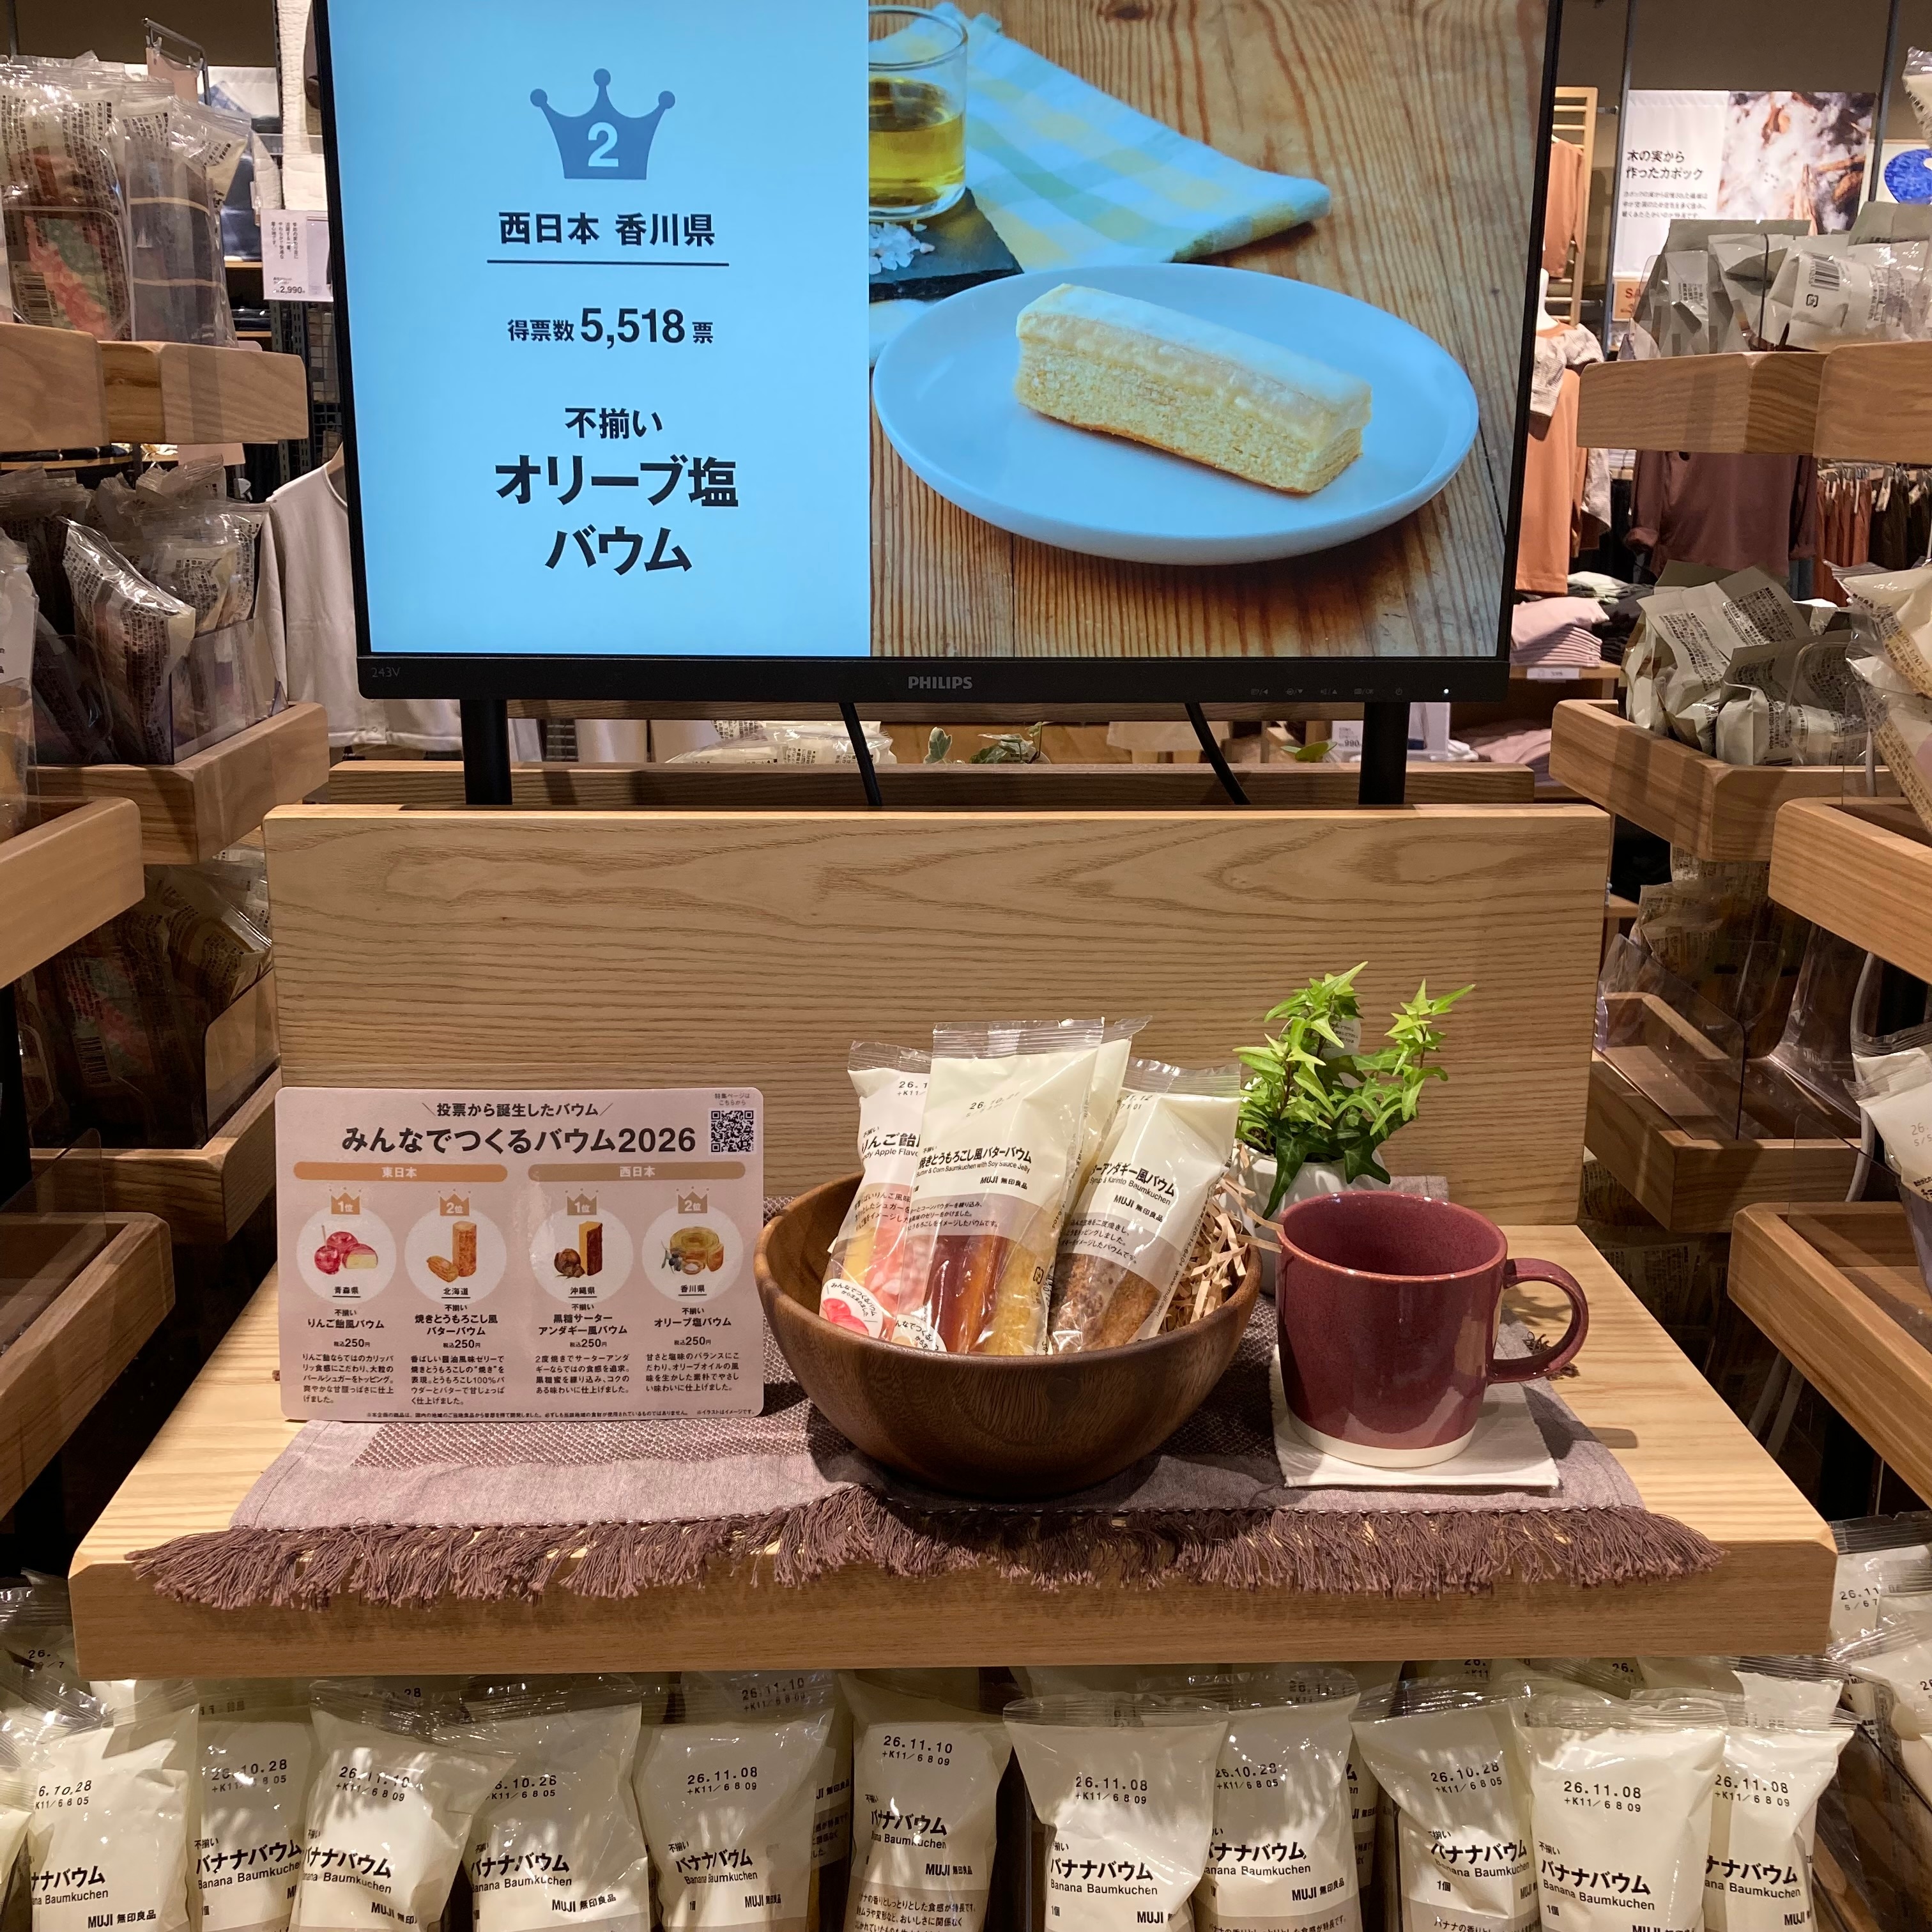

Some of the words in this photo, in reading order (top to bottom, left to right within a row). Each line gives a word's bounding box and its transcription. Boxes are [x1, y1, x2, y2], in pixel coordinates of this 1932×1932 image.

[588, 121, 620, 168] 2
[1627, 150, 1685, 163] 木の実から
[1626, 166, 1704, 181] 作ったカポック
[499, 211, 600, 247] 西日本
[615, 213, 716, 248] 香川県
[565, 407, 663, 440] 不揃い
[495, 454, 739, 507] オリーブ塩
[546, 524, 693, 576] バウム
[371, 666, 401, 678] 243V
[908, 676, 973, 689] PHILIPS
[342, 1127, 696, 1154] みんなでつくるバウム2026
[862, 1133, 921, 1154] りんご飴
[874, 1147, 896, 1157] Apple
[381, 1167, 417, 1179] 東日本
[619, 1166, 656, 1178] 西日本
[980, 1176, 999, 1184] MUJI
[1000, 1177, 1028, 1190] 無印良品
[1128, 1180, 1171, 1206] Baumkuchen
[337, 1200, 354, 1213] 1位
[446, 1202, 464, 1214] 2位
[574, 1201, 591, 1213] 1位
[684, 1200, 702, 1212] 2位
[1114, 1194, 1135, 1208] MUJI
[1136, 1204, 1164, 1222] 無印良品
[334, 1286, 359, 1294] 青森県
[443, 1287, 468, 1296] 北海道
[570, 1286, 595, 1295] 沖縄県
[680, 1285, 705, 1293] 香川県
[334, 1308, 357, 1317] 不揃い
[415, 1314, 498, 1324] 焼きとうもろこし風
[553, 1314, 613, 1324] 黒糖サーター
[307, 1318, 385, 1330] りんご飴風バウム
[654, 1317, 732, 1328] オリーブ塩バウム
[427, 1326, 486, 1336] バターバウム
[538, 1325, 627, 1336] アンダギー風バウム
[334, 1338, 371, 1348] 税込250円
[443, 1339, 481, 1349] 税込250円
[569, 1338, 607, 1348] 税込250円
[674, 1336, 711, 1346] 税込250円
[535, 1385, 629, 1394] ある味わいに仕上げました。
[646, 1383, 733, 1392] い味わいに仕上げました。
[303, 1395, 334, 1404] げました。
[411, 1397, 464, 1406] く仕上げました。
[883, 1735, 953, 1754] 26.11.10
[938, 1757, 950, 1766] 09
[687, 1767, 757, 1785] 26.11.08
[1215, 1763, 1277, 1778] 26.10.28
[1430, 1762, 1499, 1782] 26.10.28
[273, 1775, 286, 1784] 05
[745, 1782, 757, 1790] 09
[1076, 1776, 1147, 1791] 26.11.08
[1266, 1779, 1278, 1787] 05
[1491, 1777, 1502, 1786] 05
[1715, 1774, 1788, 1793] 26.11.08
[39, 1780, 92, 1797] 6.10.28
[543, 1789, 556, 1797] 05
[1564, 1781, 1641, 1798] 26.11.08
[77, 1797, 89, 1806] 05
[392, 1792, 405, 1802] 09
[1135, 1795, 1147, 1804] 09
[1777, 1797, 1790, 1807] 09
[1627, 1803, 1641, 1813] 09
[194, 1837, 218, 1850] 不揃い
[668, 1840, 689, 1853] 不揃い
[1538, 1841, 1560, 1855] 不揃い
[196, 1839, 302, 1874] バナナバウム
[1430, 1839, 1527, 1865] バナナバウム
[305, 1845, 392, 1878] バナナバウム
[471, 1852, 570, 1878] バナナバウム
[675, 1848, 753, 1873] バナナバウム
[926, 1863, 950, 1876] MUJI
[1050, 1857, 1154, 1882] バナナバウム
[1241, 1864, 1311, 1876] Baumkuchen
[1475, 1861, 1529, 1878] Baumkuchen
[198, 1876, 233, 1889] Banana
[323, 1872, 392, 1894] Baumkuchen
[504, 1876, 572, 1889] Baumkuchen
[707, 1871, 758, 1883] Baumkuchen
[1541, 1859, 1652, 1896] バナナバウム
[1050, 1878, 1082, 1893] Banana
[1087, 1883, 1158, 1896] Baumkuchen
[1292, 1887, 1317, 1901] MUJI
[1320, 1877, 1345, 1896] 無印良品
[1437, 1880, 1452, 1892] 1個
[1729, 1882, 1801, 1899] Baumkuchen
[45, 1889, 109, 1905] Baumkuchen
[1544, 1879, 1575, 1899] Banana
[1579, 1892, 1655, 1910] Baumkuchen
[552, 1899, 576, 1912] MUJI
[579, 1894, 617, 1911] 無印良品
[744, 1895, 764, 1908] MUJI
[371, 1901, 395, 1918] MUJI
[88, 1913, 113, 1929] MUJI
[117, 1909, 157, 1924] 無印良品
[1137, 1911, 1164, 1924] MUJI
[1784, 1911, 1805, 1926] MUJI
